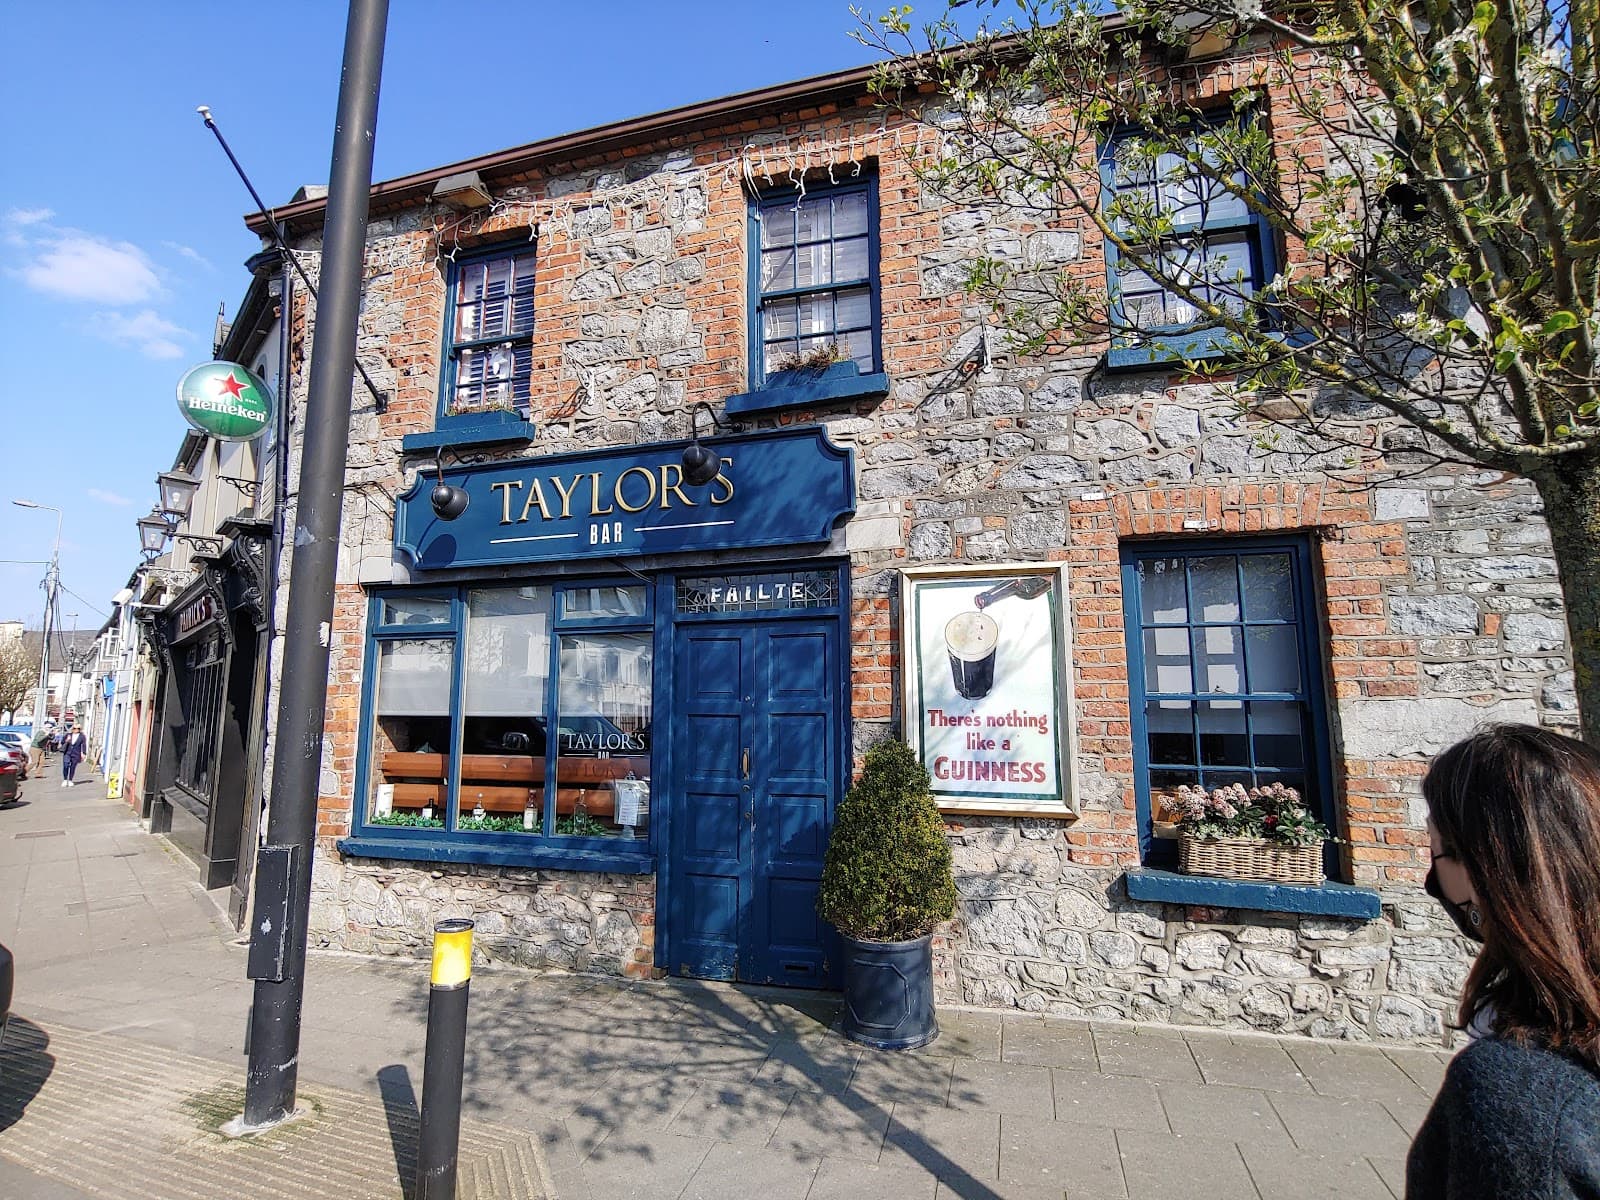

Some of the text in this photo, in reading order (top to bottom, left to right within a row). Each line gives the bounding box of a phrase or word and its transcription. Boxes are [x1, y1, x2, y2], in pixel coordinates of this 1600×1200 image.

[189, 397, 265, 422] Heineken
[490, 457, 734, 523] TAYLORS
[590, 522, 622, 545] BAR
[927, 709, 1048, 735] There's nothing
[565, 733, 645, 750] TAYLOR'S
[966, 732, 1011, 750] like a
[934, 756, 1047, 783] GUINNESS
